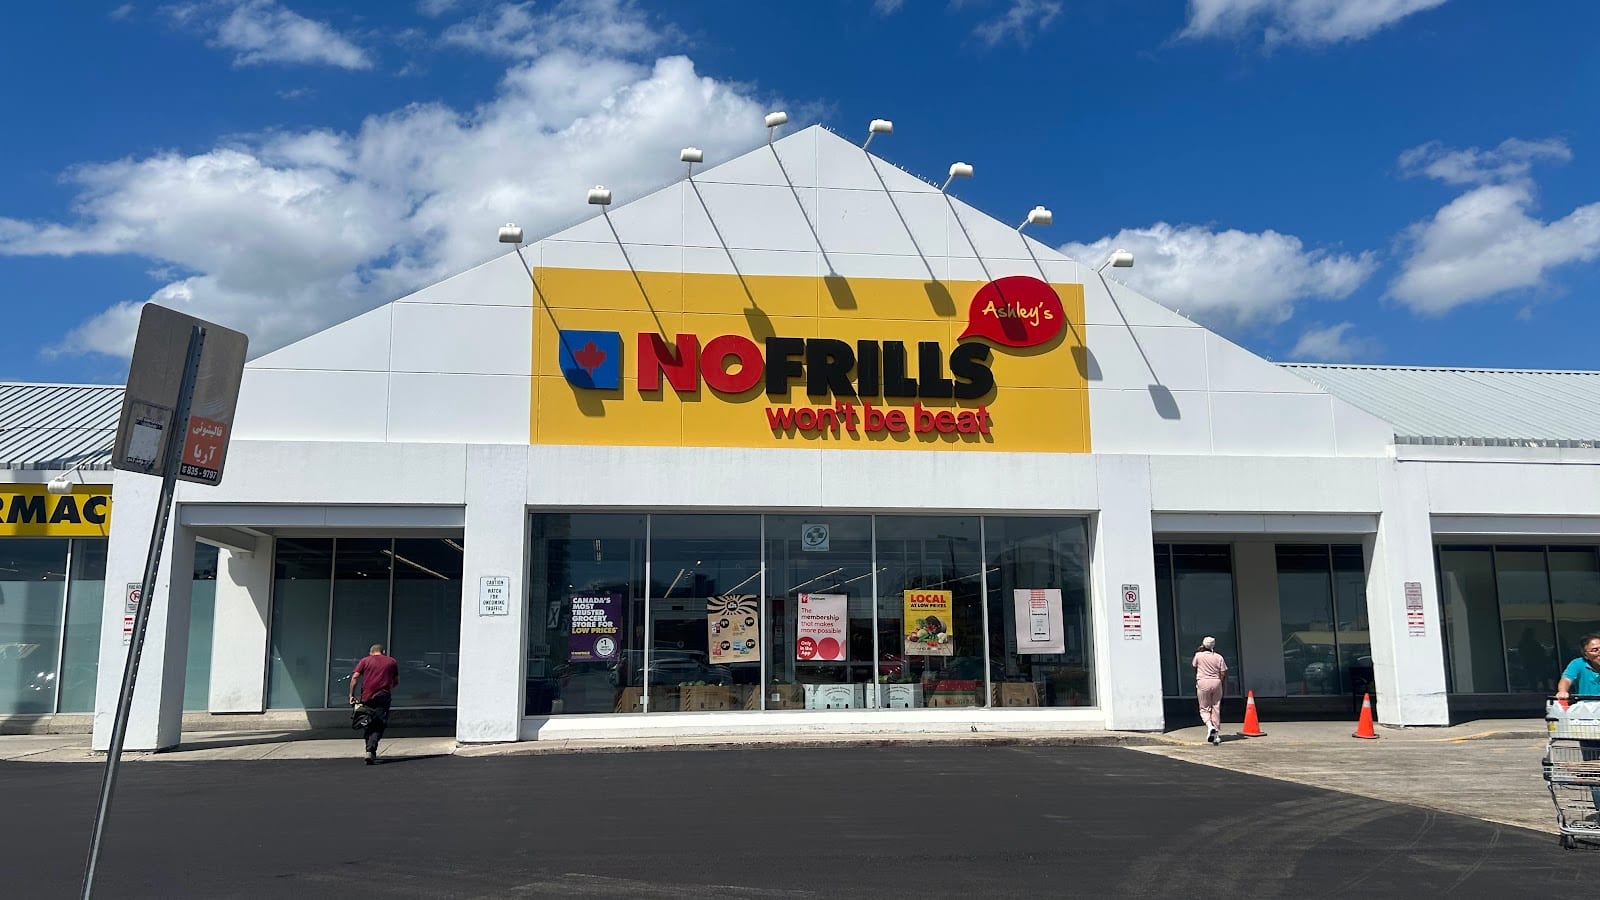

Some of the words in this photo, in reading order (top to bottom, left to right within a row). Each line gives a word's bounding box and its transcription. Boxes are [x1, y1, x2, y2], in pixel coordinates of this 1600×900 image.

[982, 301, 1053, 326] Ashley's
[765, 400, 856, 431] won't
[864, 401, 906, 431] be
[913, 402, 990, 433] beat
[0, 495, 113, 524] MAC
[910, 594, 946, 603] LOCAL
[801, 614, 840, 622] membership
